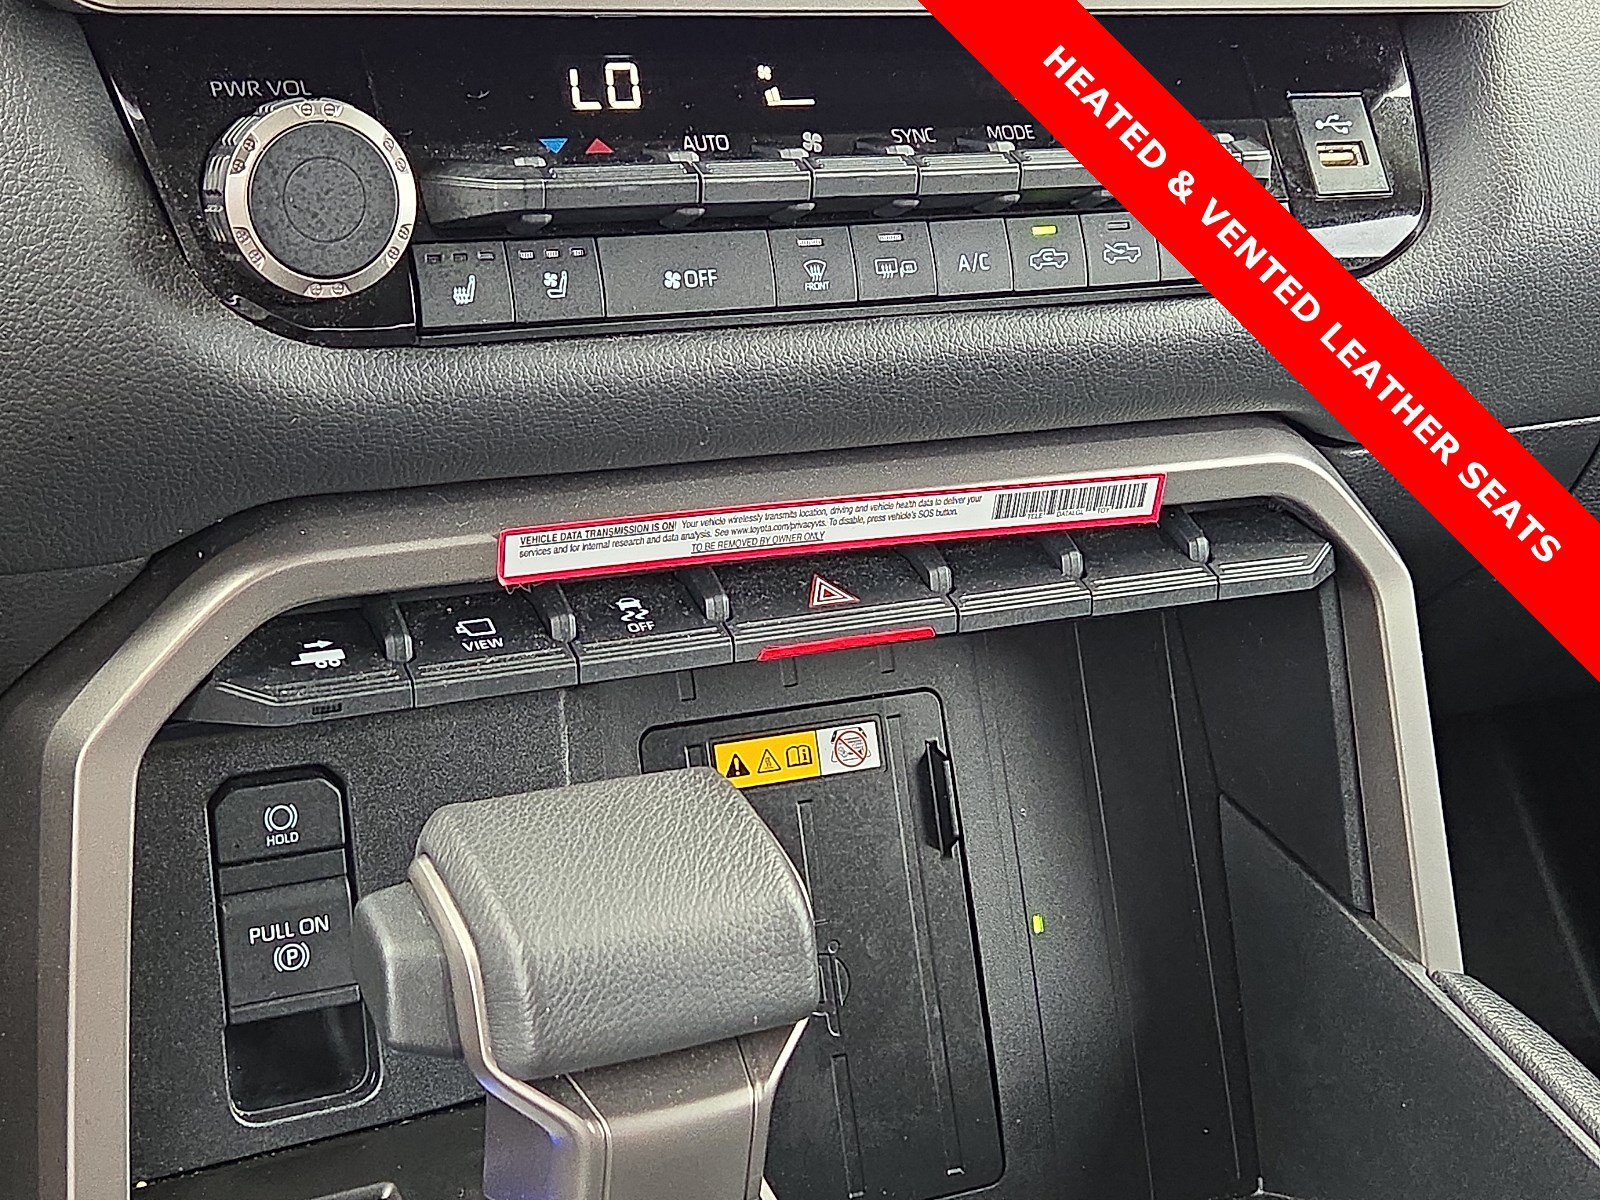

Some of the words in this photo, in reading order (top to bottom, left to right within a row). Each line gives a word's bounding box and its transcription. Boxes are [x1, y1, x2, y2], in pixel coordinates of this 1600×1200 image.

[209, 80, 262, 98] PWR
[266, 79, 312, 97] VOL
[890, 127, 938, 145] SYNC
[986, 124, 1035, 141] MODE
[683, 134, 730, 152] AUTO
[958, 252, 991, 273] A/C
[683, 268, 718, 288] OFF
[804, 280, 831, 291] FRONT
[520, 532, 558, 545] VEHICLE
[560, 529, 583, 541] DATA
[585, 523, 650, 539] TRANSMISSION
[651, 522, 660, 532] IS
[681, 518, 699, 530] Your
[700, 516, 726, 528] vehicle
[728, 512, 764, 526] wirelessly
[765, 509, 798, 521] transmits
[798, 506, 828, 519] location,
[830, 502, 854, 516] driving
[855, 502, 868, 512] and
[870, 500, 895, 512] vehicle
[896, 498, 917, 509] health
[918, 498, 934, 508] data
[943, 495, 966, 505] deliver
[966, 494, 982, 505] your
[519, 546, 551, 559] services
[553, 544, 568, 555] and
[569, 542, 580, 552] for
[611, 536, 645, 549] research
[646, 534, 661, 544] and
[662, 532, 679, 543] data
[714, 527, 729, 538] See
[829, 516, 838, 527] To
[866, 512, 887, 525] press
[887, 508, 918, 522] vehicle's
[918, 508, 935, 518] SOS
[691, 542, 702, 554] TO
[704, 539, 716, 550] BE
[717, 536, 758, 550] REMOVED
[760, 535, 771, 546] BY
[772, 532, 803, 545] OWNER
[803, 530, 826, 542] ONLY
[627, 620, 657, 633] OFF
[461, 637, 504, 652] VIEW
[266, 831, 299, 847] HOLD
[249, 921, 295, 945] PULL
[299, 914, 330, 936] ON
